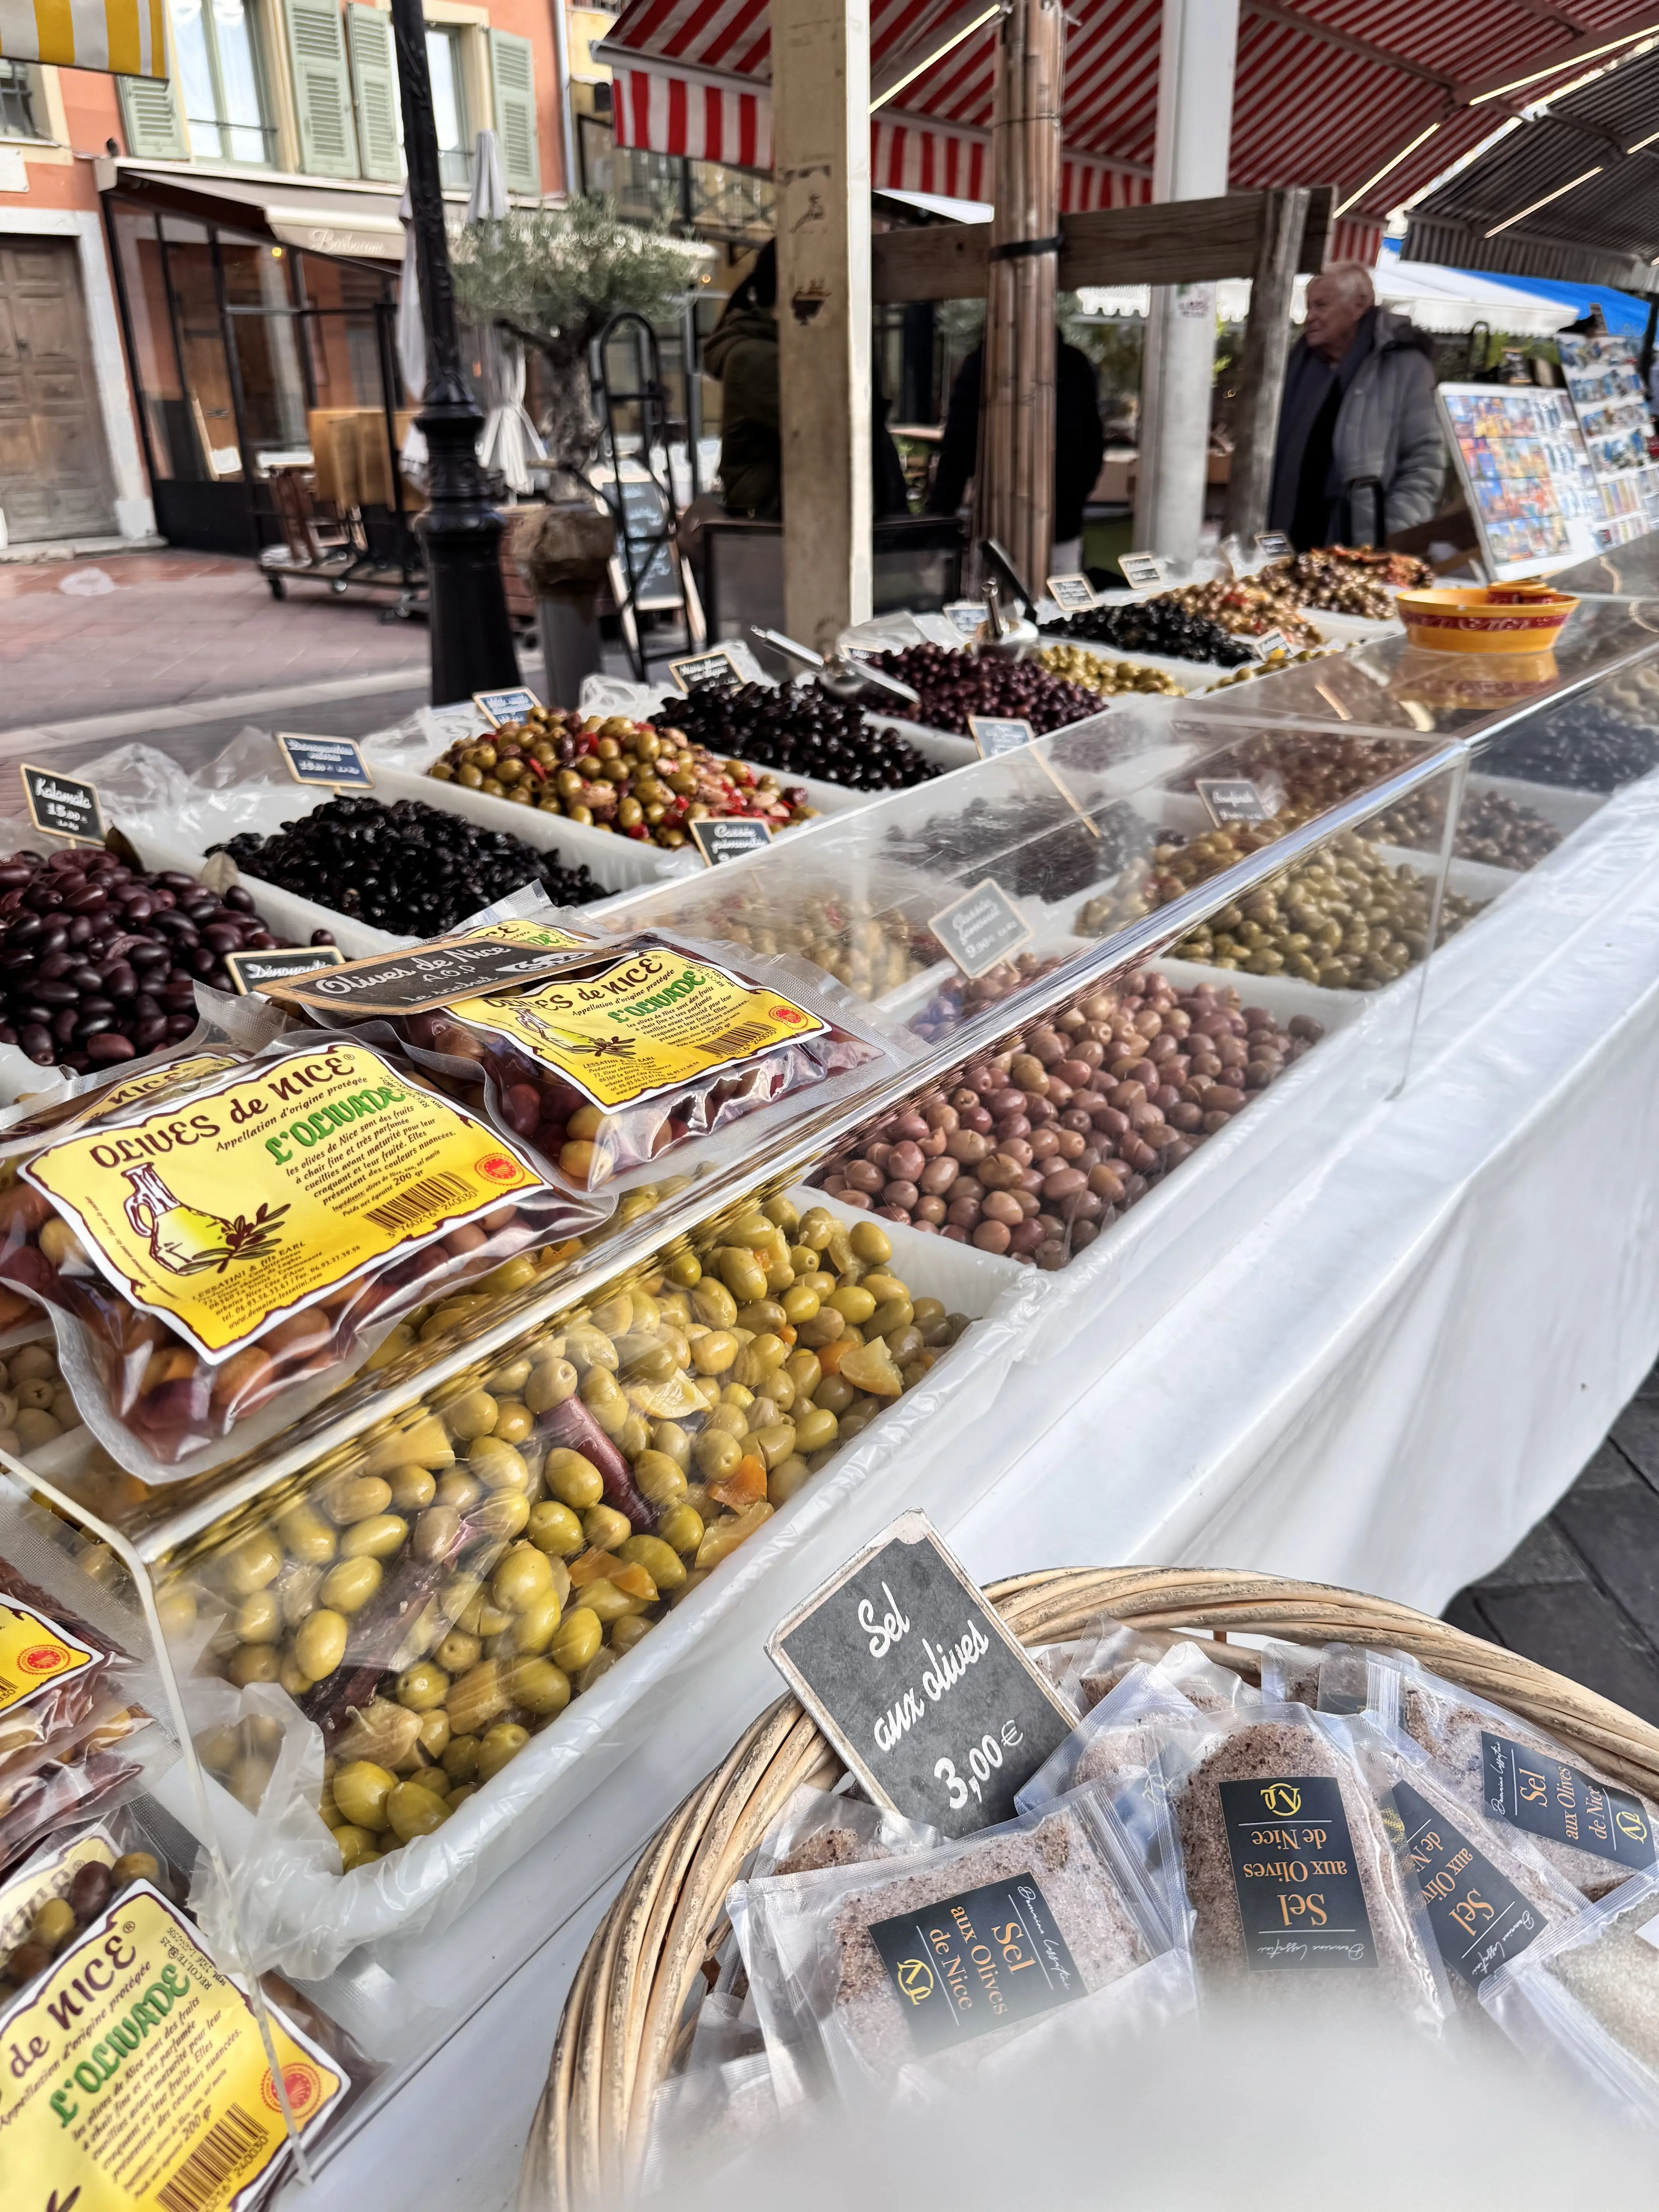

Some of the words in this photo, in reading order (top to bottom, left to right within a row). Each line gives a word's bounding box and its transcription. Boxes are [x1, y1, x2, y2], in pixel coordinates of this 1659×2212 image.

[316, 967, 416, 994] Olives
[410, 953, 453, 972] de
[443, 945, 511, 963] Nice
[399, 991, 431, 1003] le
[433, 976, 499, 996] sachet
[572, 1002, 613, 1016] Appellation
[615, 989, 645, 1004] d'origine
[646, 969, 675, 993] protégée
[576, 988, 605, 1002] de
[685, 996, 712, 1013] parfumée
[698, 986, 714, 997] fruits
[708, 1000, 720, 1010] pour
[713, 1005, 727, 1013] Elles
[709, 1026, 723, 1035] 200
[90, 1115, 220, 1169] OLIVES
[230, 1099, 268, 1124] de
[216, 1117, 276, 1152] Appellation
[280, 1092, 324, 1118] d'origine
[327, 1077, 367, 1096] protégée
[266, 1085, 405, 1165] L'OLIVADE
[286, 1166, 299, 1176] les
[301, 1151, 325, 1168] olives
[327, 1143, 337, 1153] de
[339, 1130, 358, 1146] Nice
[360, 1120, 377, 1132] sont
[393, 1106, 414, 1120] fruits
[304, 1164, 325, 1180] chair
[328, 1153, 344, 1168] fine
[346, 1146, 355, 1156] et
[356, 1135, 372, 1149] très
[374, 1119, 409, 1140] parfumée
[305, 1169, 340, 1191] cueillies
[342, 1153, 365, 1170] avant
[367, 1130, 401, 1156] maturité
[403, 1125, 419, 1136] pour
[420, 1119, 435, 1127] leur
[314, 1173, 351, 1198] craquant
[353, 1166, 362, 1175] et
[363, 1158, 379, 1169] leur
[382, 1141, 407, 1162] fruité.
[407, 1131, 427, 1143] Elles
[323, 1175, 366, 1206] présentent
[369, 1168, 382, 1176] des
[385, 1148, 417, 1170] couleurs
[419, 1132, 455, 1150] nuancées.
[332, 1191, 365, 1211] Ingrédients:
[366, 1180, 381, 1192] olives
[389, 1171, 404, 1180] Nice,
[404, 1166, 417, 1175] eau,
[425, 1150, 440, 1162] marin
[343, 1206, 359, 1217] Poids
[360, 1199, 371, 1208] net
[371, 1184, 393, 1201] égoutté
[393, 1173, 412, 1186] 200
[401, 1211, 436, 1235] 760216
[443, 1189, 477, 1212] 240030
[192, 1271, 246, 1302] LESSATINI
[279, 1242, 305, 1259] EARL
[858, 1581, 910, 1657] Sel
[874, 1687, 925, 1751] aux
[922, 1620, 989, 1701] olives
[1518, 1768, 1548, 1808] Sel
[1556, 1766, 1576, 1808] Olives
[1585, 1785, 1604, 1820] Nice
[1251, 1829, 1301, 1850] Nice
[1302, 1829, 1327, 1850] de
[1420, 1831, 1444, 1851] de
[1565, 1810, 1579, 1840] aux
[1589, 1819, 1608, 1839] de
[1243, 1861, 1308, 1882] Olives
[1310, 1860, 1347, 1875] aux
[1445, 1848, 1473, 1876] aux
[1420, 1871, 1456, 1904] Oliv
[1277, 1894, 1327, 1926] Sel
[1448, 1888, 1494, 1936] Sel
[929, 1929, 951, 1955] de
[941, 1954, 972, 2010] Nice
[950, 1906, 977, 1944] aux
[971, 1944, 1008, 2014] Olives
[991, 1922, 1036, 1975] Sel
[177, 1953, 212, 1990] RECOLTE
[210, 1969, 227, 1988] sept.
[62, 2009, 105, 2060] d'origine
[110, 1961, 151, 2012] protégée
[165, 2021, 178, 2039] des
[179, 1997, 200, 2024] fruits
[188, 2028, 205, 2053] pour
[206, 2010, 221, 2030] leur
[10, 2036, 50, 2078] de
[50, 1963, 191, 2128] L'OLIVADE
[160, 2021, 195, 2064] parfumée
[194, 2040, 213, 2064] Elles
[206, 2029, 242, 2071] nuancées.
[182, 2115, 201, 2142] 200
[203, 2104, 211, 2121] gr
[234, 2135, 268, 2178] 240030
